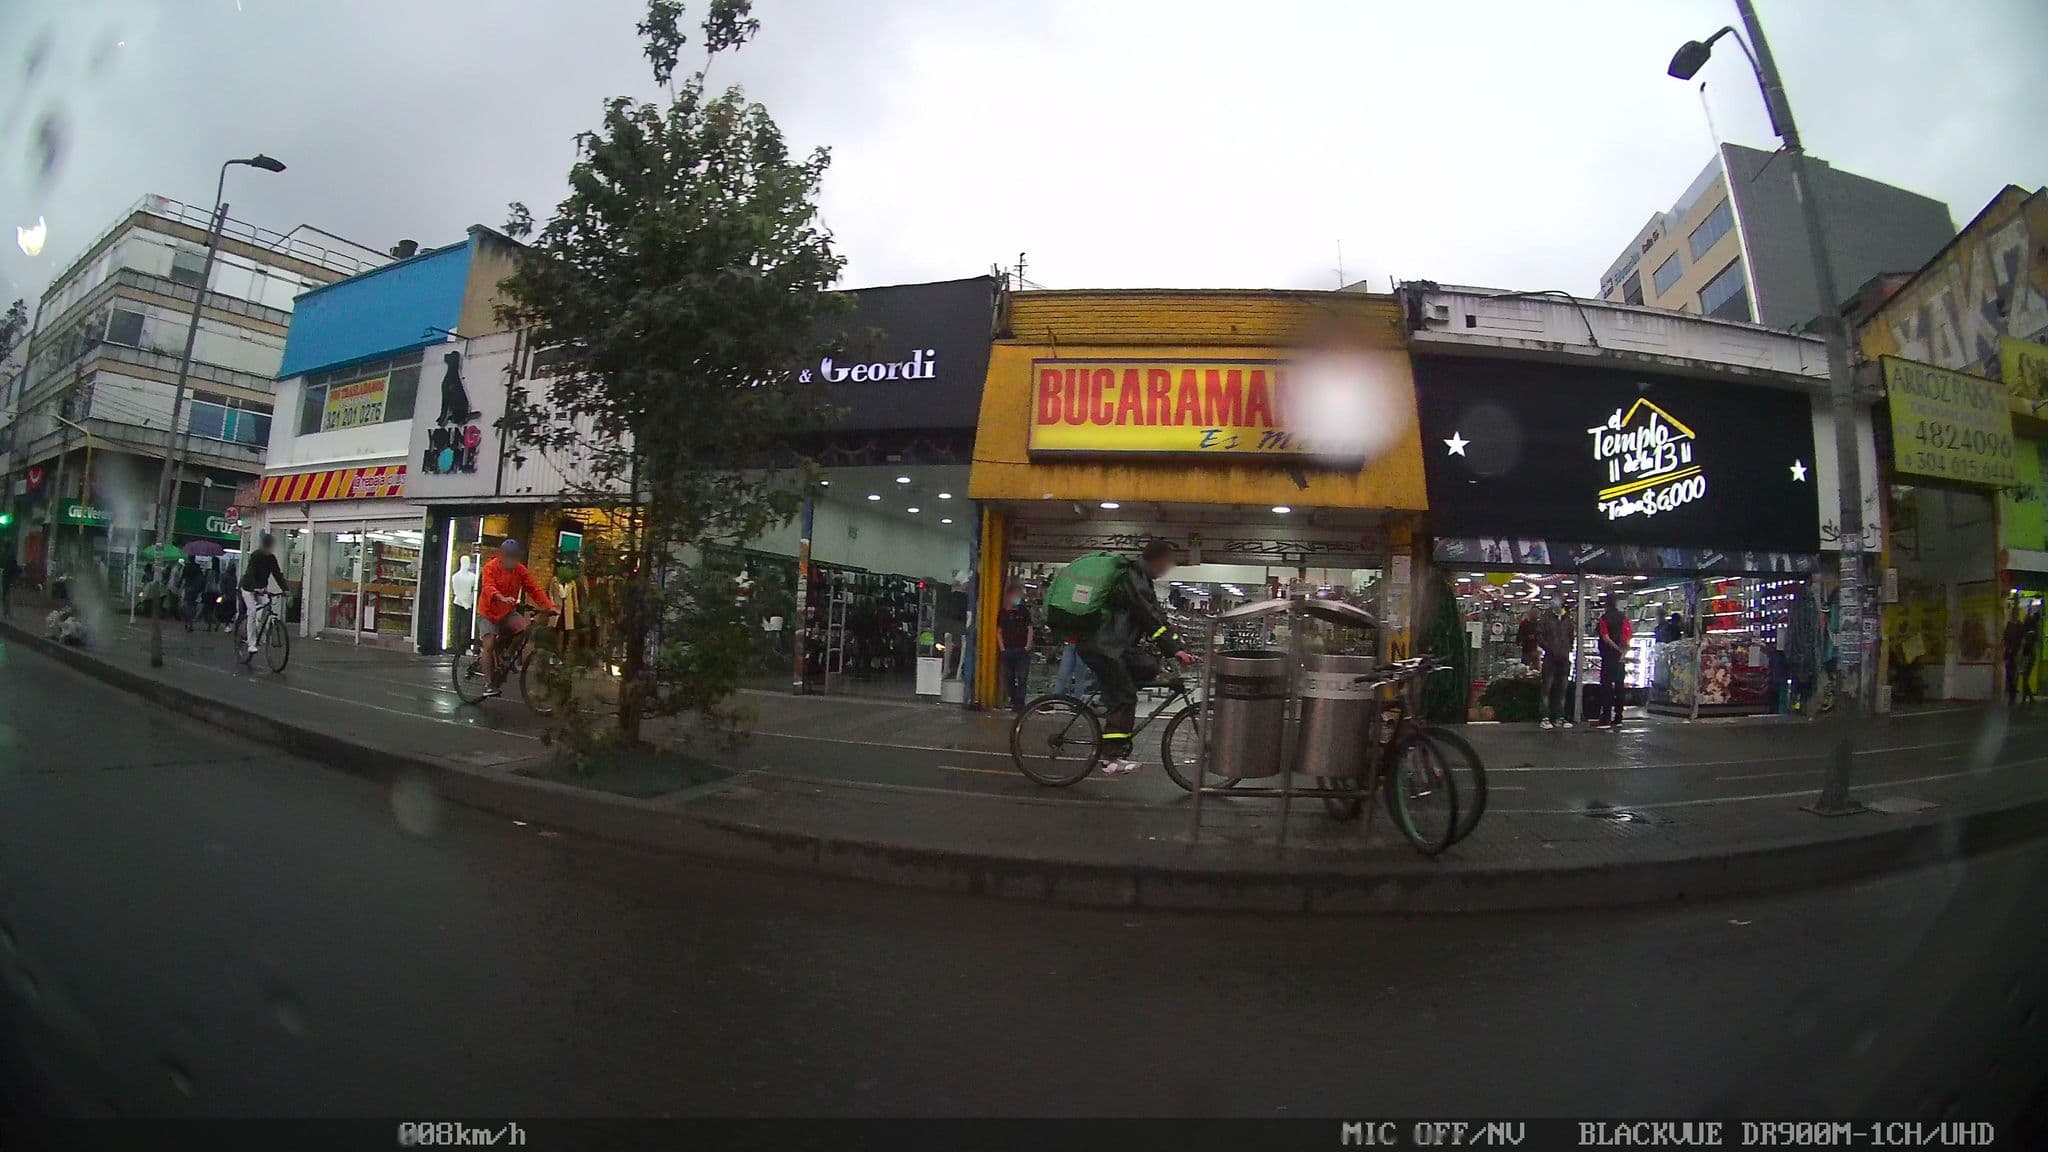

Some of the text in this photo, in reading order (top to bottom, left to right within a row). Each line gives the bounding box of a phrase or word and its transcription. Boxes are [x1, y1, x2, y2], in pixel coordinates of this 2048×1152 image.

[798, 368, 813, 383] &
[821, 349, 936, 383] Geordi
[1038, 368, 1298, 427] BUCARAMA
[1587, 412, 1668, 461] Templo
